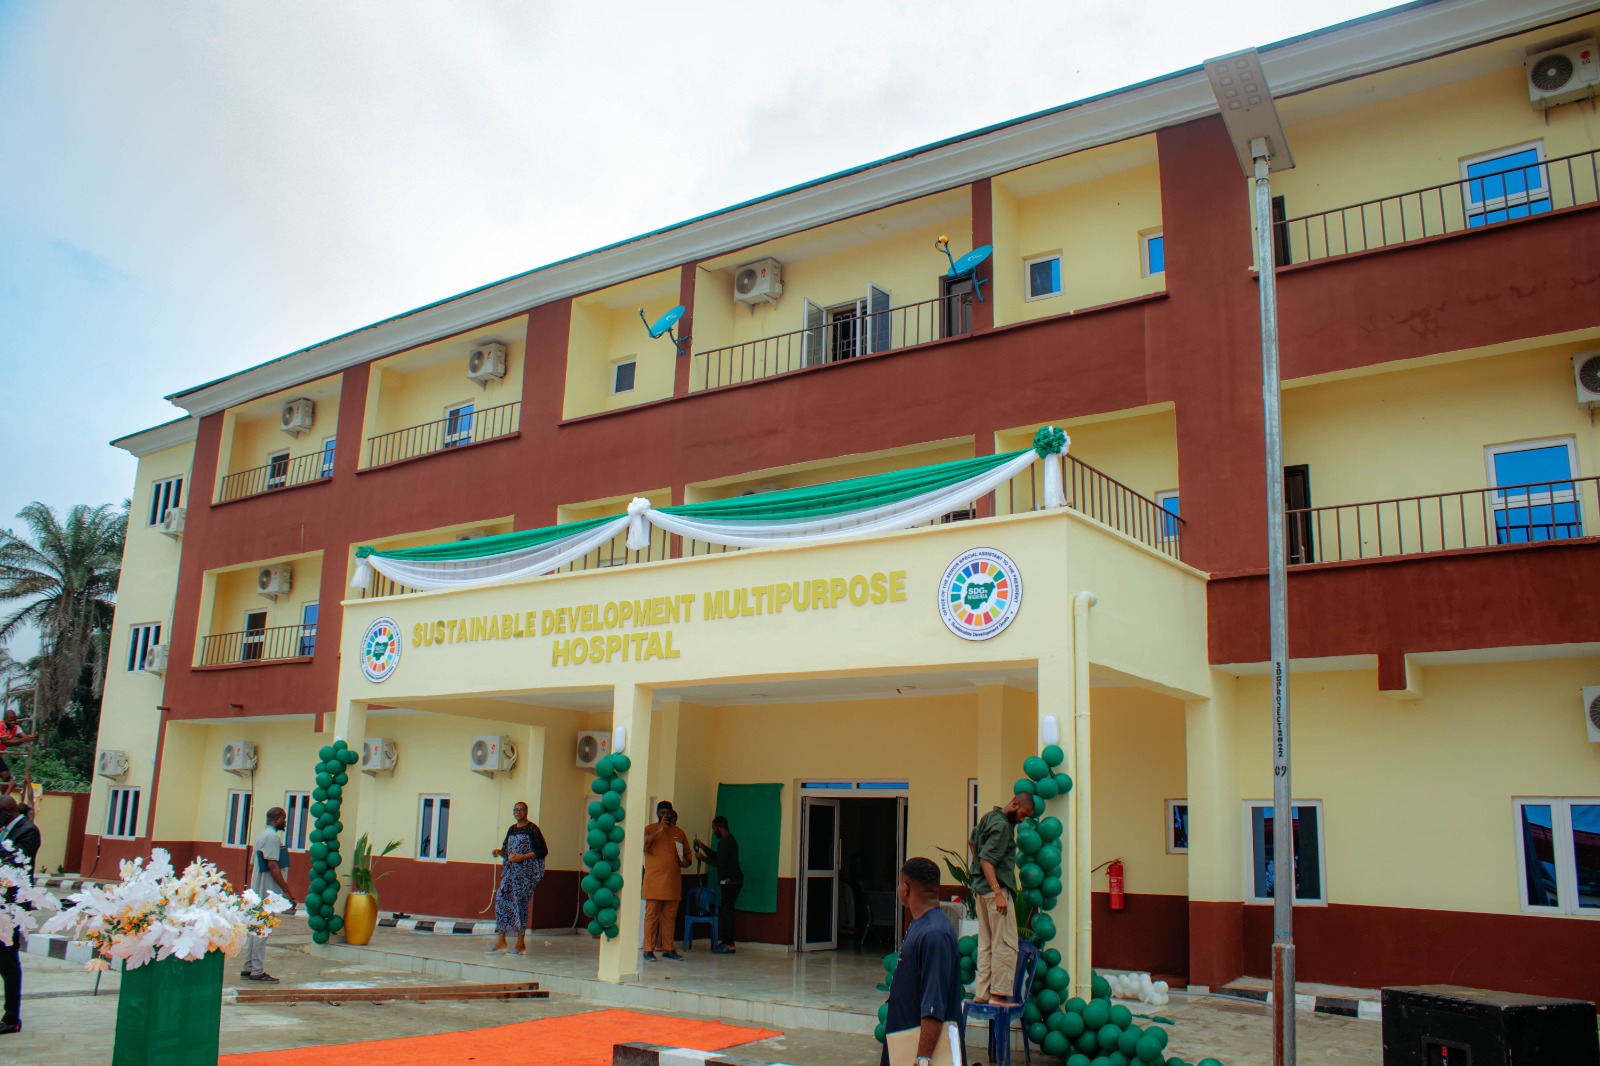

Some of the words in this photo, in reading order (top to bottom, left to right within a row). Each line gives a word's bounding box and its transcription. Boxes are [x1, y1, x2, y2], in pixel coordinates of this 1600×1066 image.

[947, 563, 960, 579] SENIOR
[959, 552, 978, 563] SPECIAL
[978, 551, 1003, 561] ASSISTANT
[412, 611, 537, 648] SUSTAINABLE
[541, 593, 696, 636] DEVELOPMENT
[703, 570, 907, 621] MULTIPURPOSE
[972, 625, 1000, 637] Development
[551, 630, 681, 667] HOSPITAL
